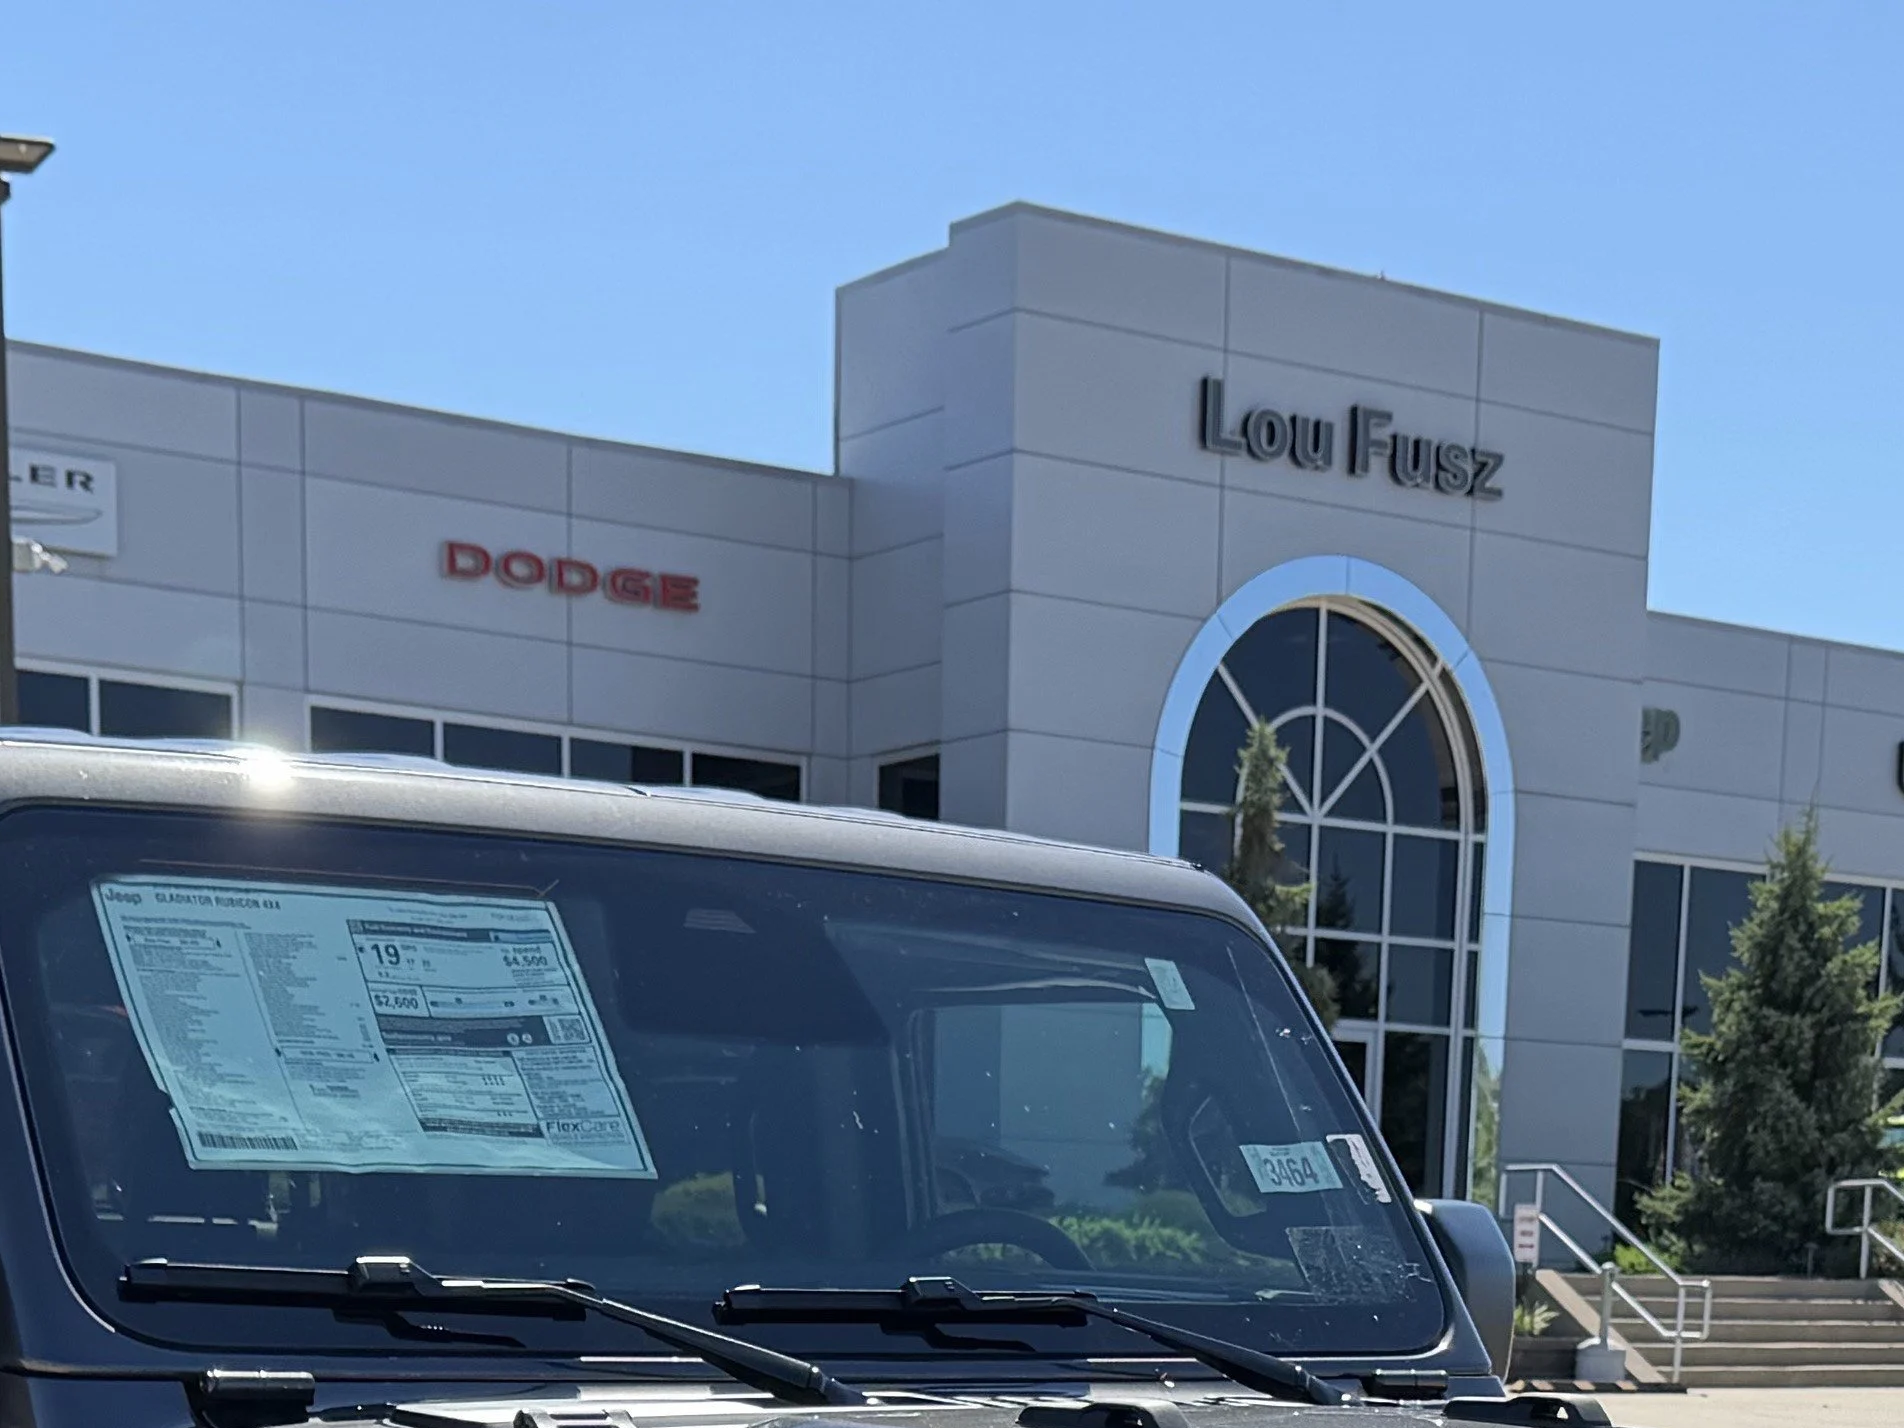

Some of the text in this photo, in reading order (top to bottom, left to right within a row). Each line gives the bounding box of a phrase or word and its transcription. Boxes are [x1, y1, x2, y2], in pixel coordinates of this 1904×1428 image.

[1197, 374, 1505, 501] Lou Fusz
[440, 540, 701, 613] DODGE
[370, 943, 402, 966] 19
[1262, 1155, 1320, 1188] 3464
